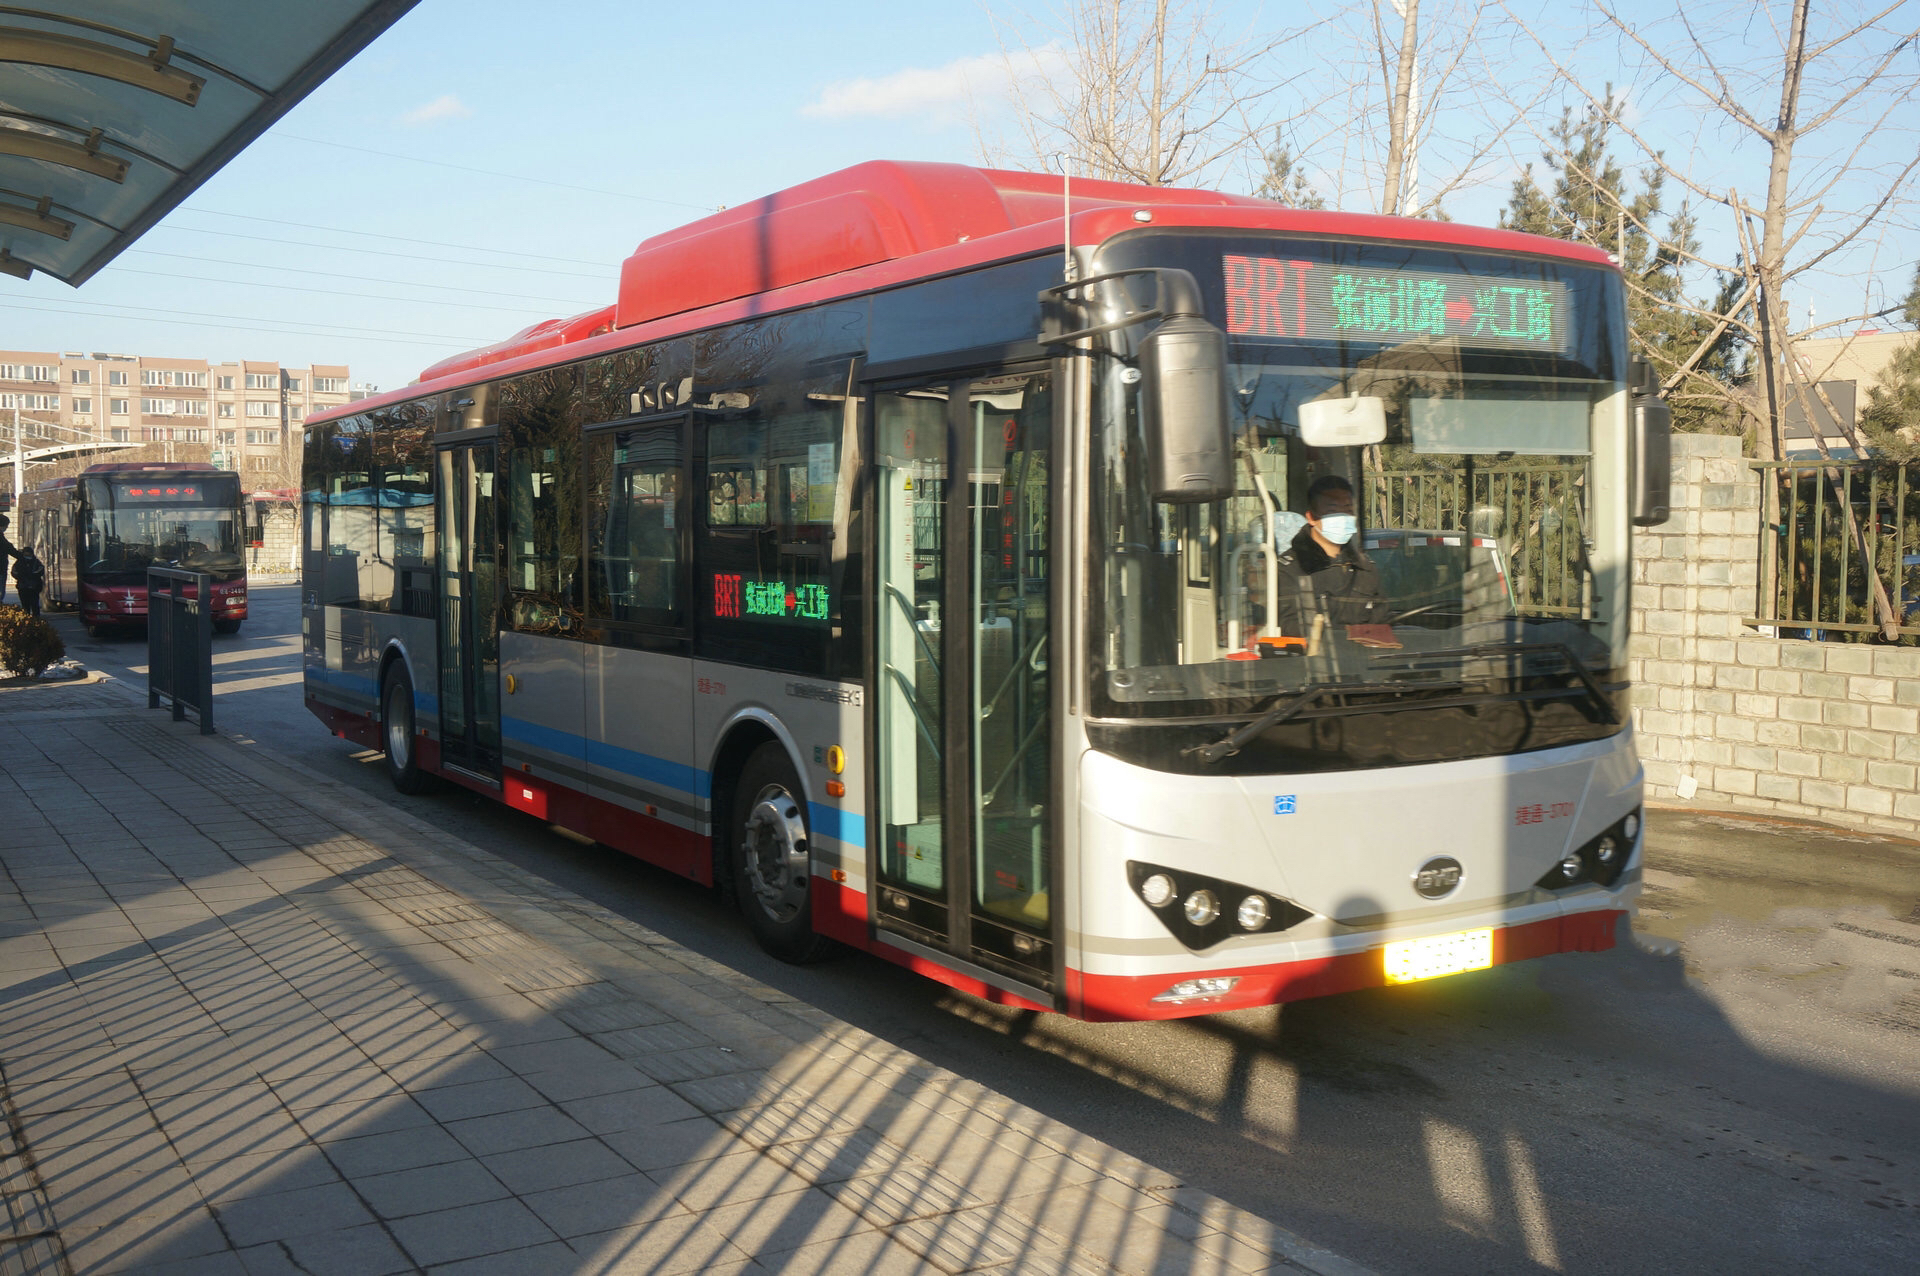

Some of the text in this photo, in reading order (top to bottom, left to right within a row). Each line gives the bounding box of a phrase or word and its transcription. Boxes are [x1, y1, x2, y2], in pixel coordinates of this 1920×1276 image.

[1225, 255, 1313, 337] BRT
[1471, 286, 1554, 341] 兴工街
[714, 574, 741, 618] BRT
[794, 584, 829, 620] 兴工街
[1417, 867, 1459, 890] BYD
